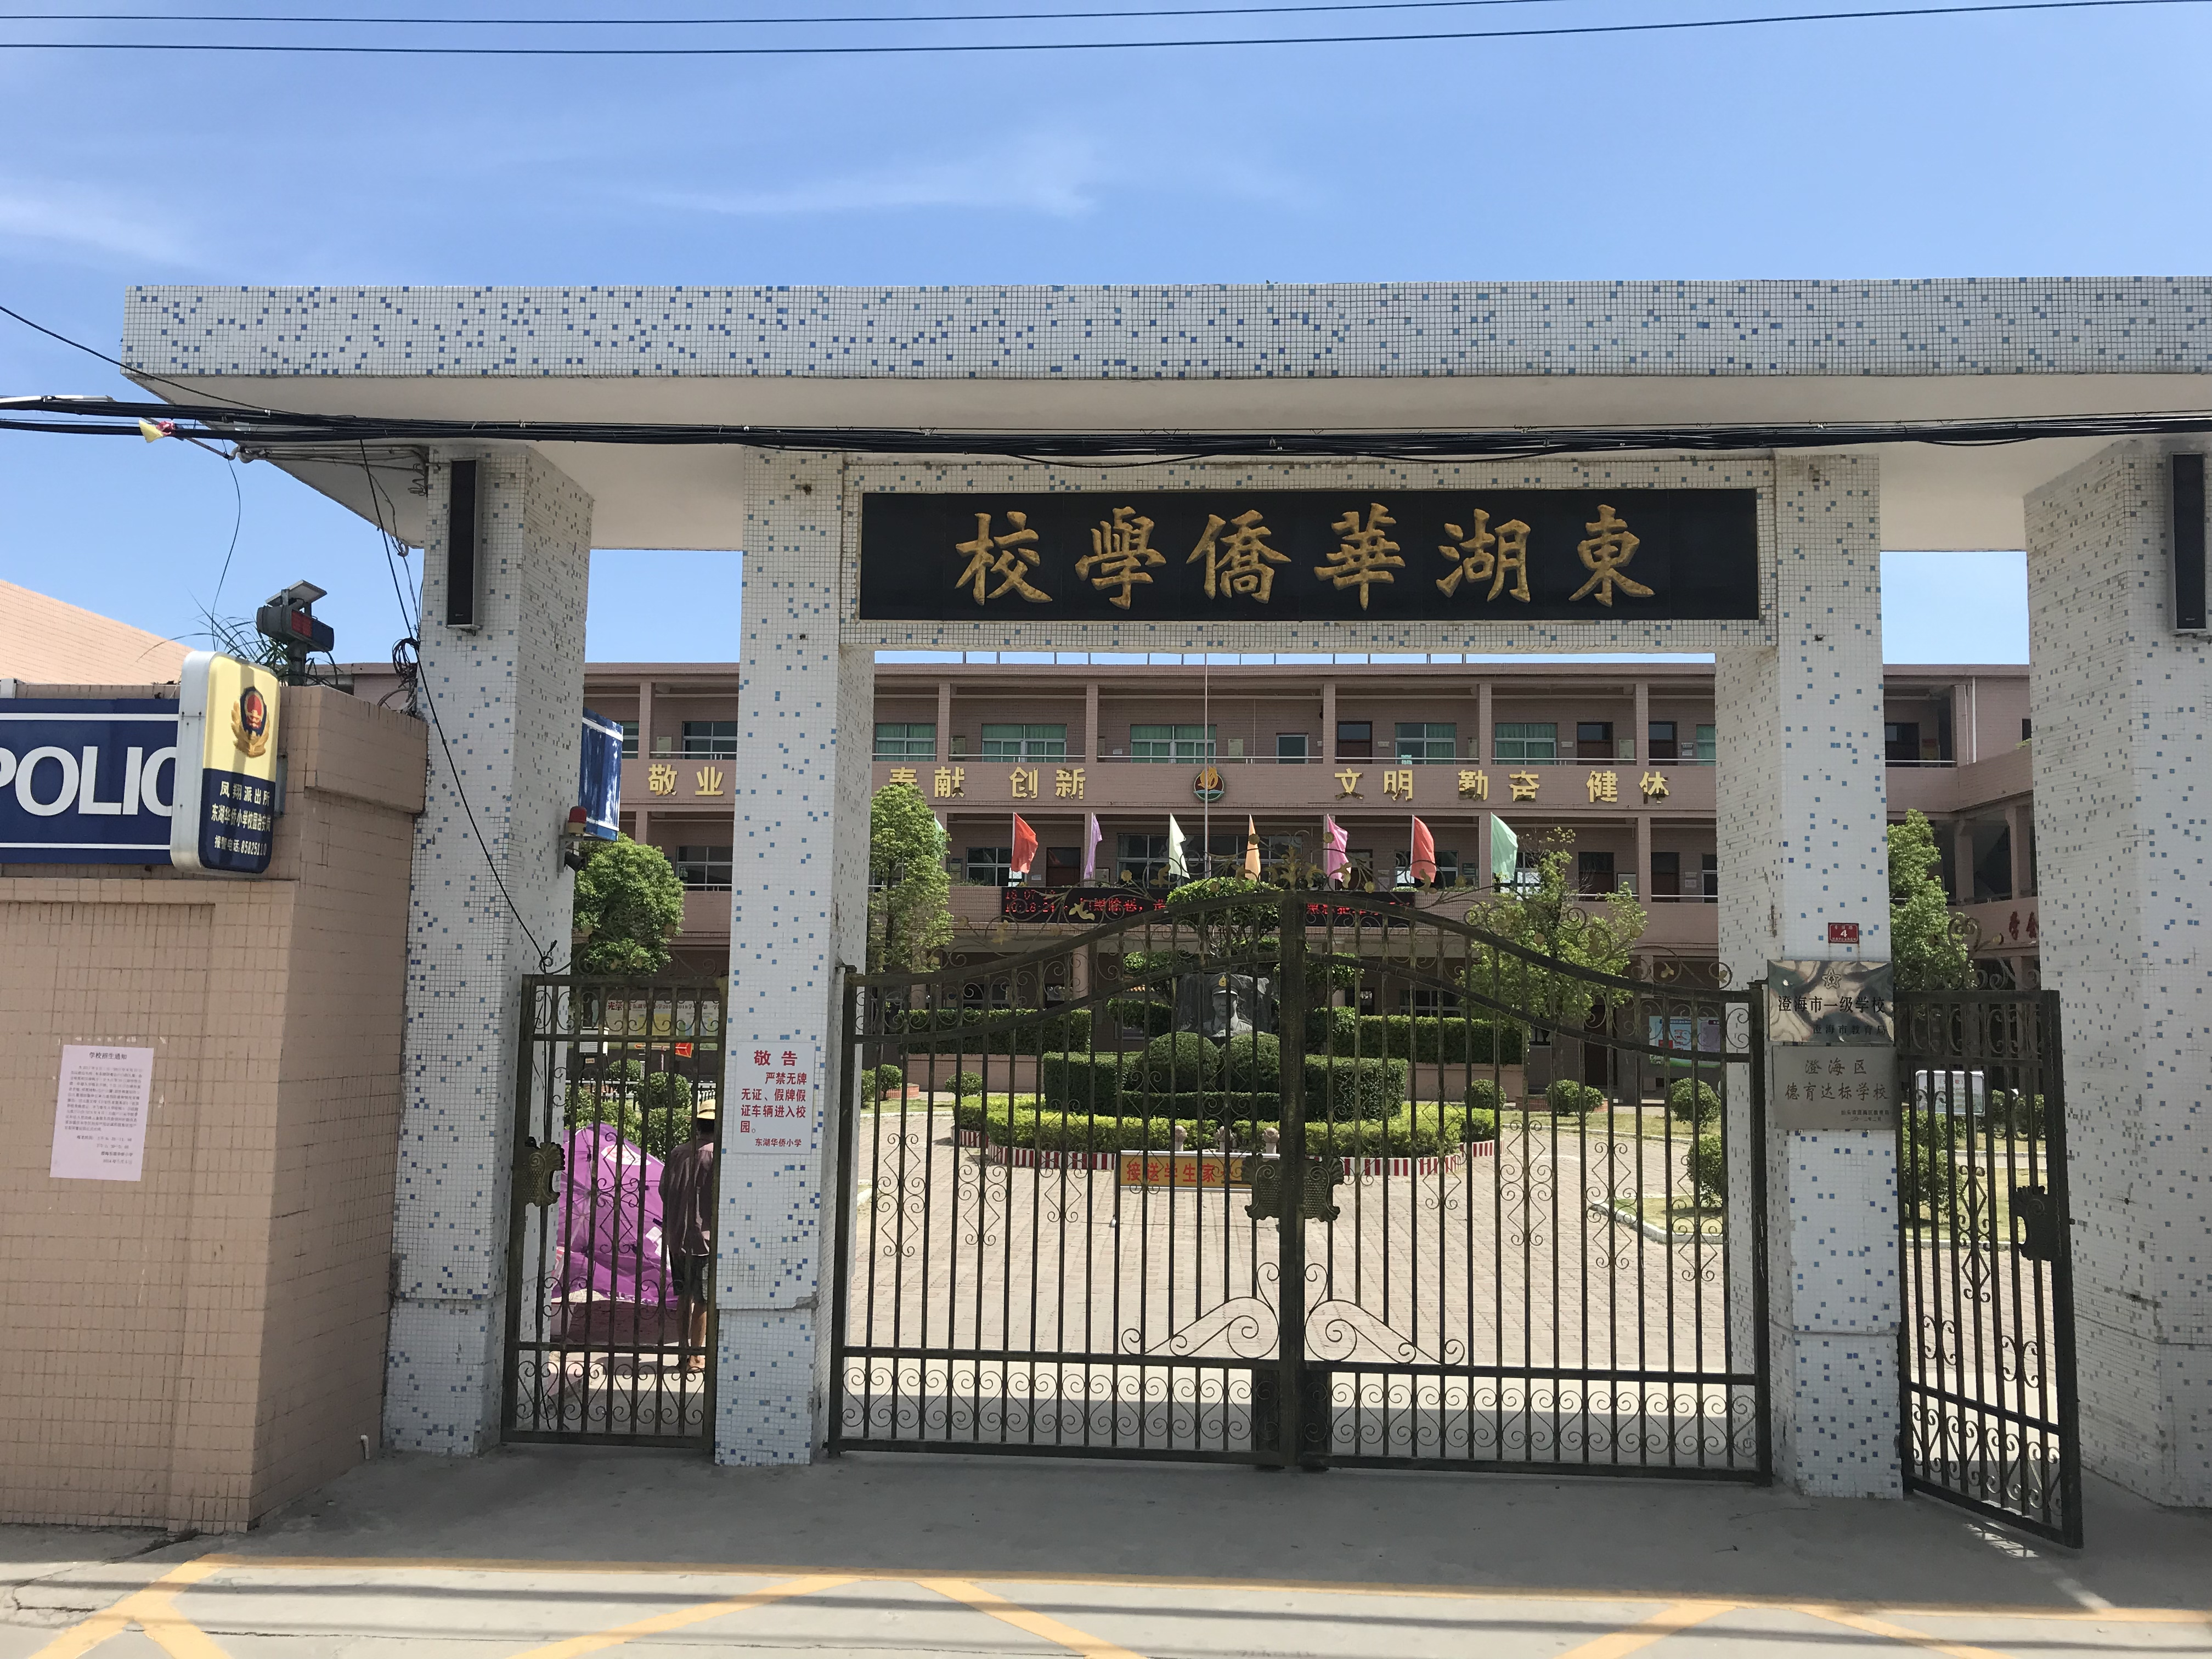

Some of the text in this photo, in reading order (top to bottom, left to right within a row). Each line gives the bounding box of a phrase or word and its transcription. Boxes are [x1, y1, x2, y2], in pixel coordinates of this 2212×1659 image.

[647, 764, 724, 797] 敬业
[1009, 766, 1087, 799] 创新
[1334, 768, 1414, 801] 文明
[219, 781, 270, 807] 凤翔派出所
[1840, 929, 1848, 938] 4
[1778, 995, 1885, 1014] 澄海市一级学校
[754, 1050, 798, 1066] 敬告
[1805, 1058, 1867, 1075] 澄海区
[765, 1072, 807, 1085] 严禁无牌
[741, 1088, 806, 1102] 无证、假牌假
[1785, 1082, 1888, 1101] 德育达标学校
[741, 1104, 806, 1119] 证车辆进入校
[755, 1138, 802, 1147] 东湖华侨小学
